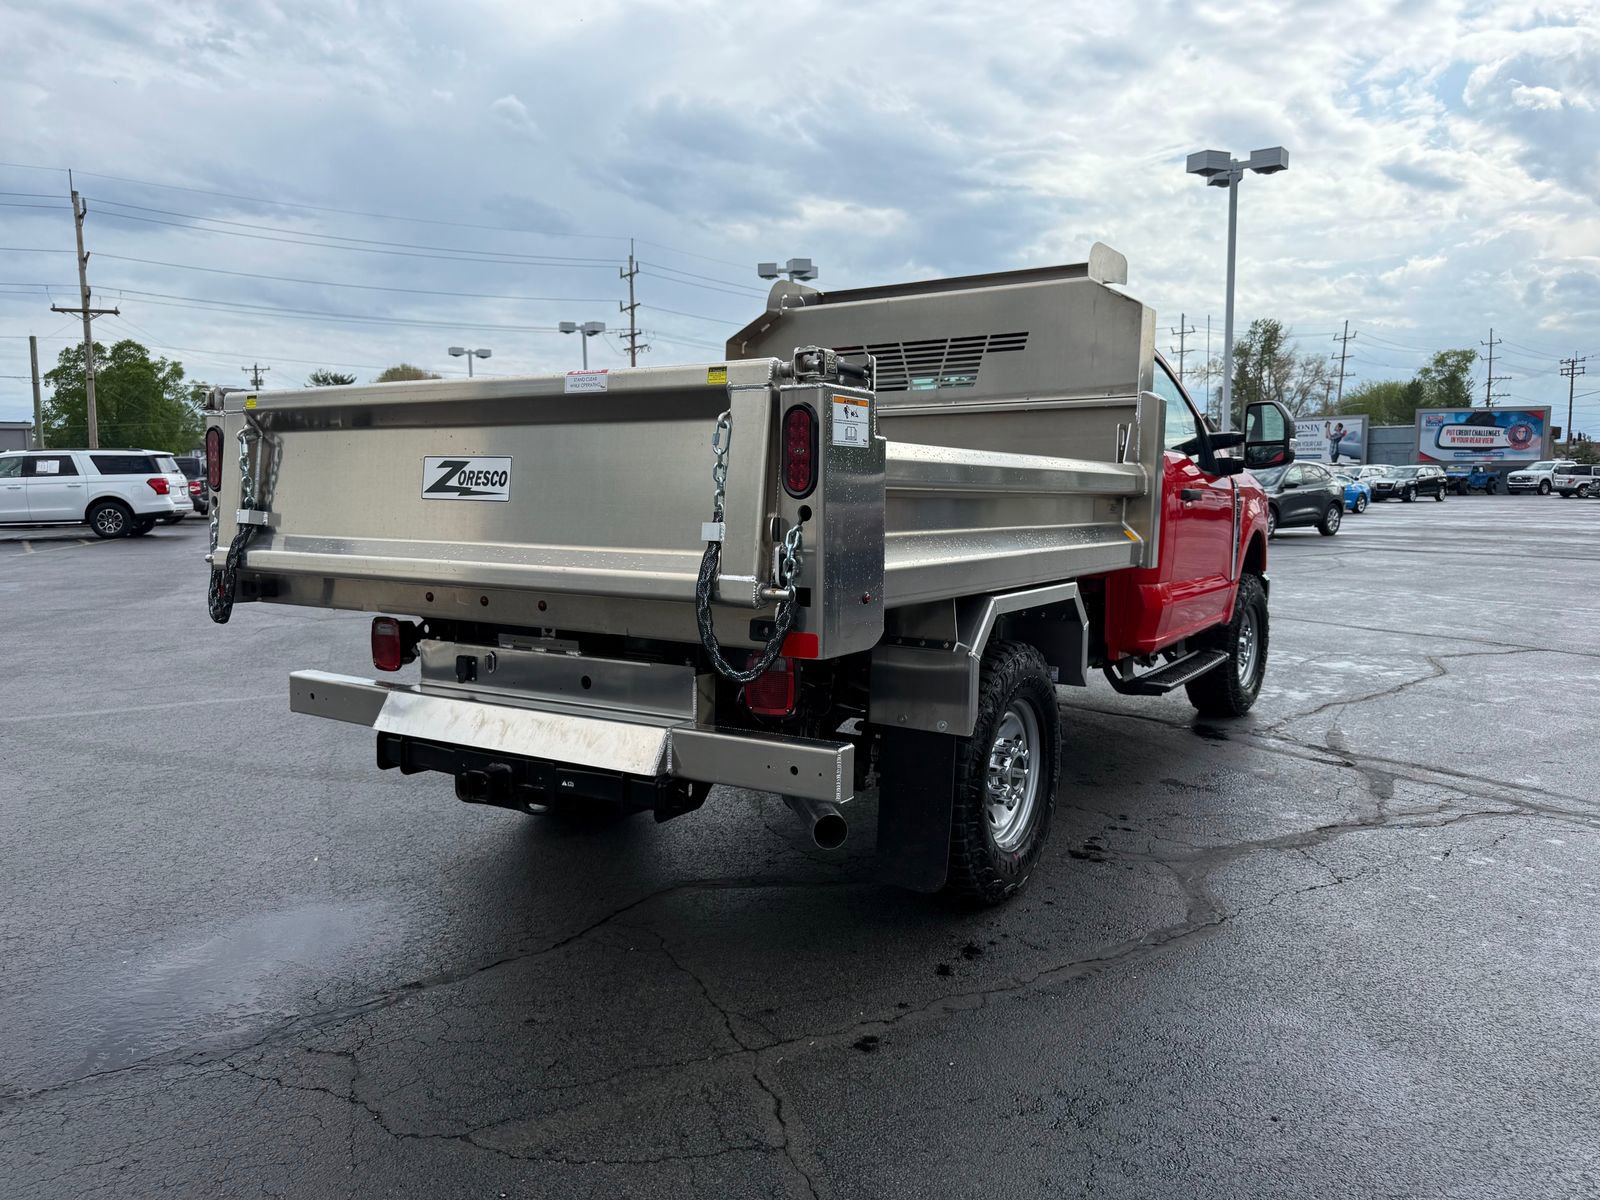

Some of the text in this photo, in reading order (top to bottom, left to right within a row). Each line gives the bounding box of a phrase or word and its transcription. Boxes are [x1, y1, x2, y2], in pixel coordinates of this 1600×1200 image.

[1296, 424, 1320, 432] ONIN
[1472, 429, 1500, 437] CHALLENGES
[424, 460, 508, 495] ZORESCO
